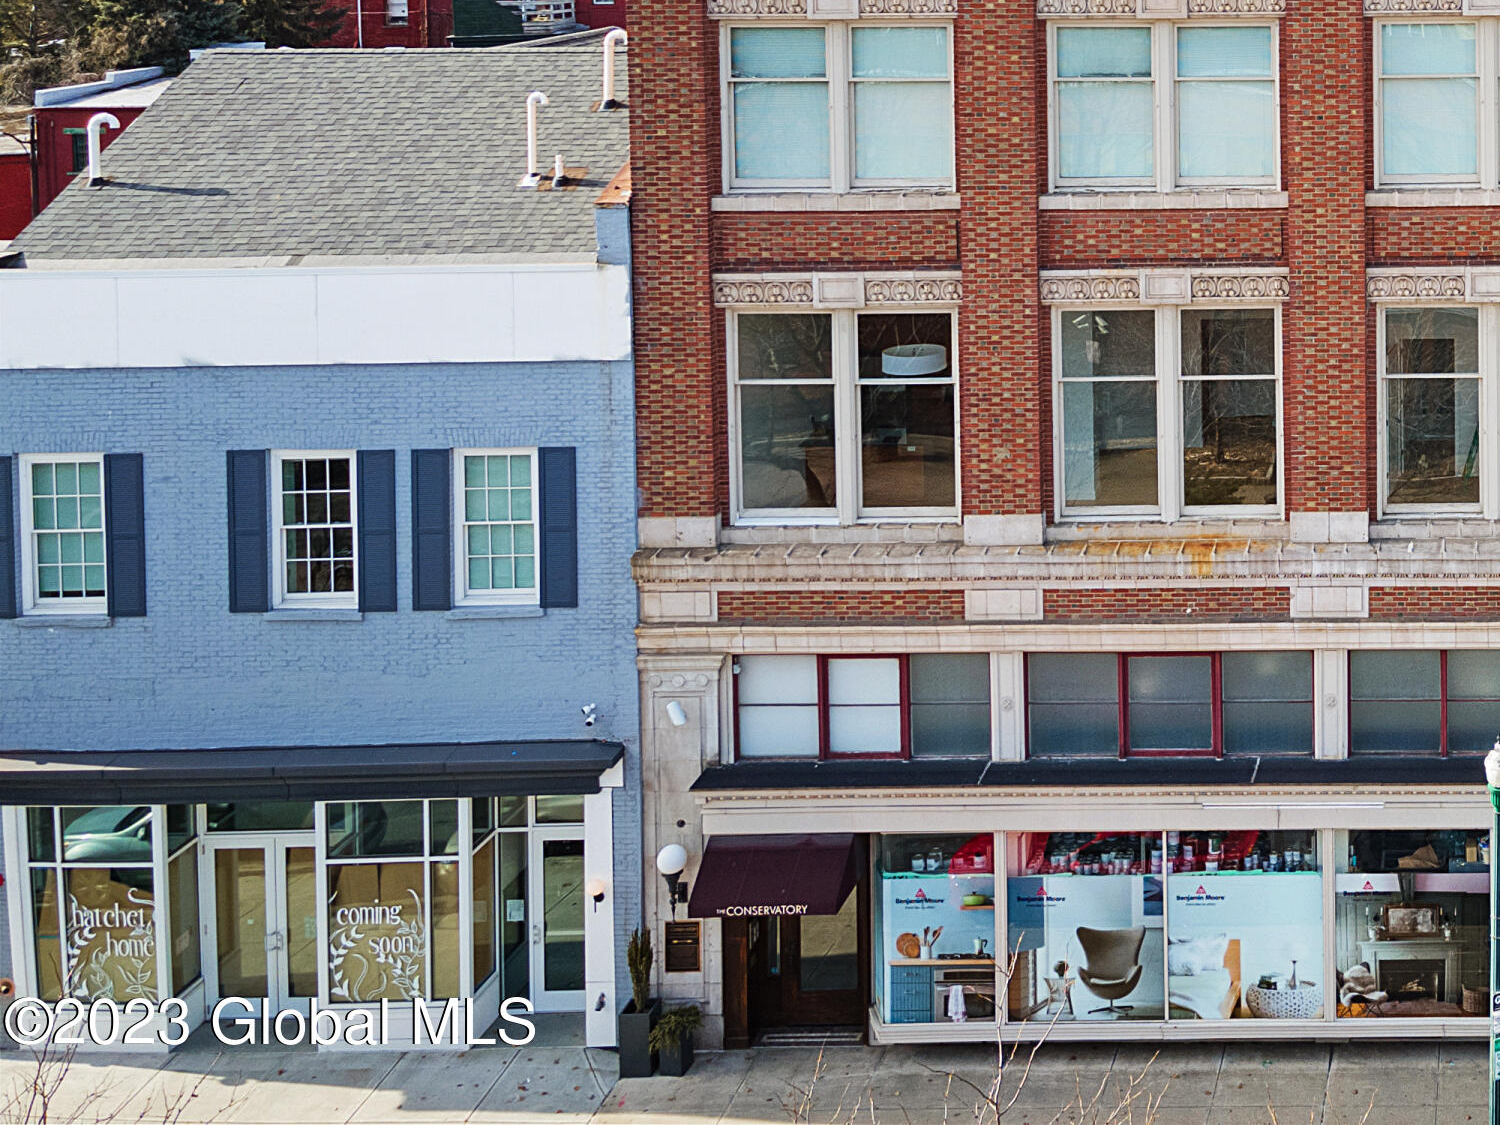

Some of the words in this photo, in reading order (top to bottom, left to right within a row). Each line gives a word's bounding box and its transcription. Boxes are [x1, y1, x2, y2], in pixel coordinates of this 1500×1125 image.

[72, 902, 146, 928] hatchet
[336, 898, 402, 926] coming
[726, 904, 808, 916] CONSERVATORY
[106, 931, 154, 957] home
[368, 935, 415, 955] soon
